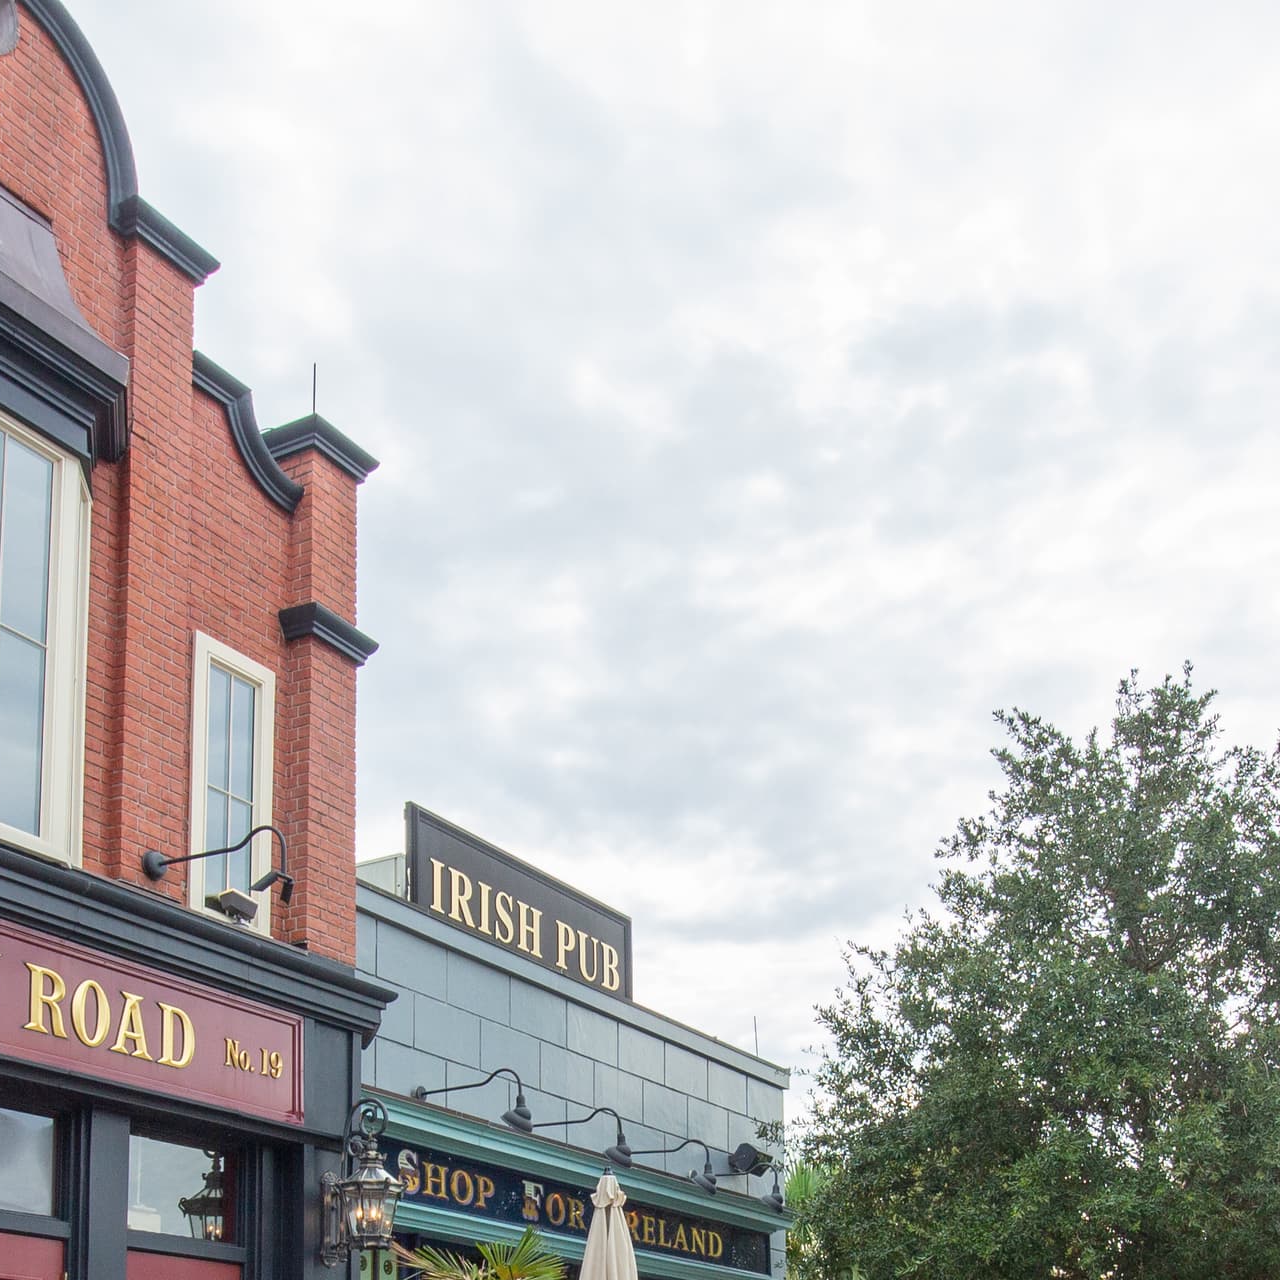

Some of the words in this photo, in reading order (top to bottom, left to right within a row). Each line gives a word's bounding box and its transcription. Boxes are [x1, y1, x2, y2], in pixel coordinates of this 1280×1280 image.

[429, 857, 544, 959] IRISH
[554, 918, 621, 992] PUB
[22, 961, 197, 1069] ROAD
[224, 1037, 255, 1073] No.
[260, 1047, 284, 1080] 19
[397, 1149, 495, 1209] SHOP
[521, 1179, 587, 1231] FOR
[624, 1208, 724, 1258] RELAND
